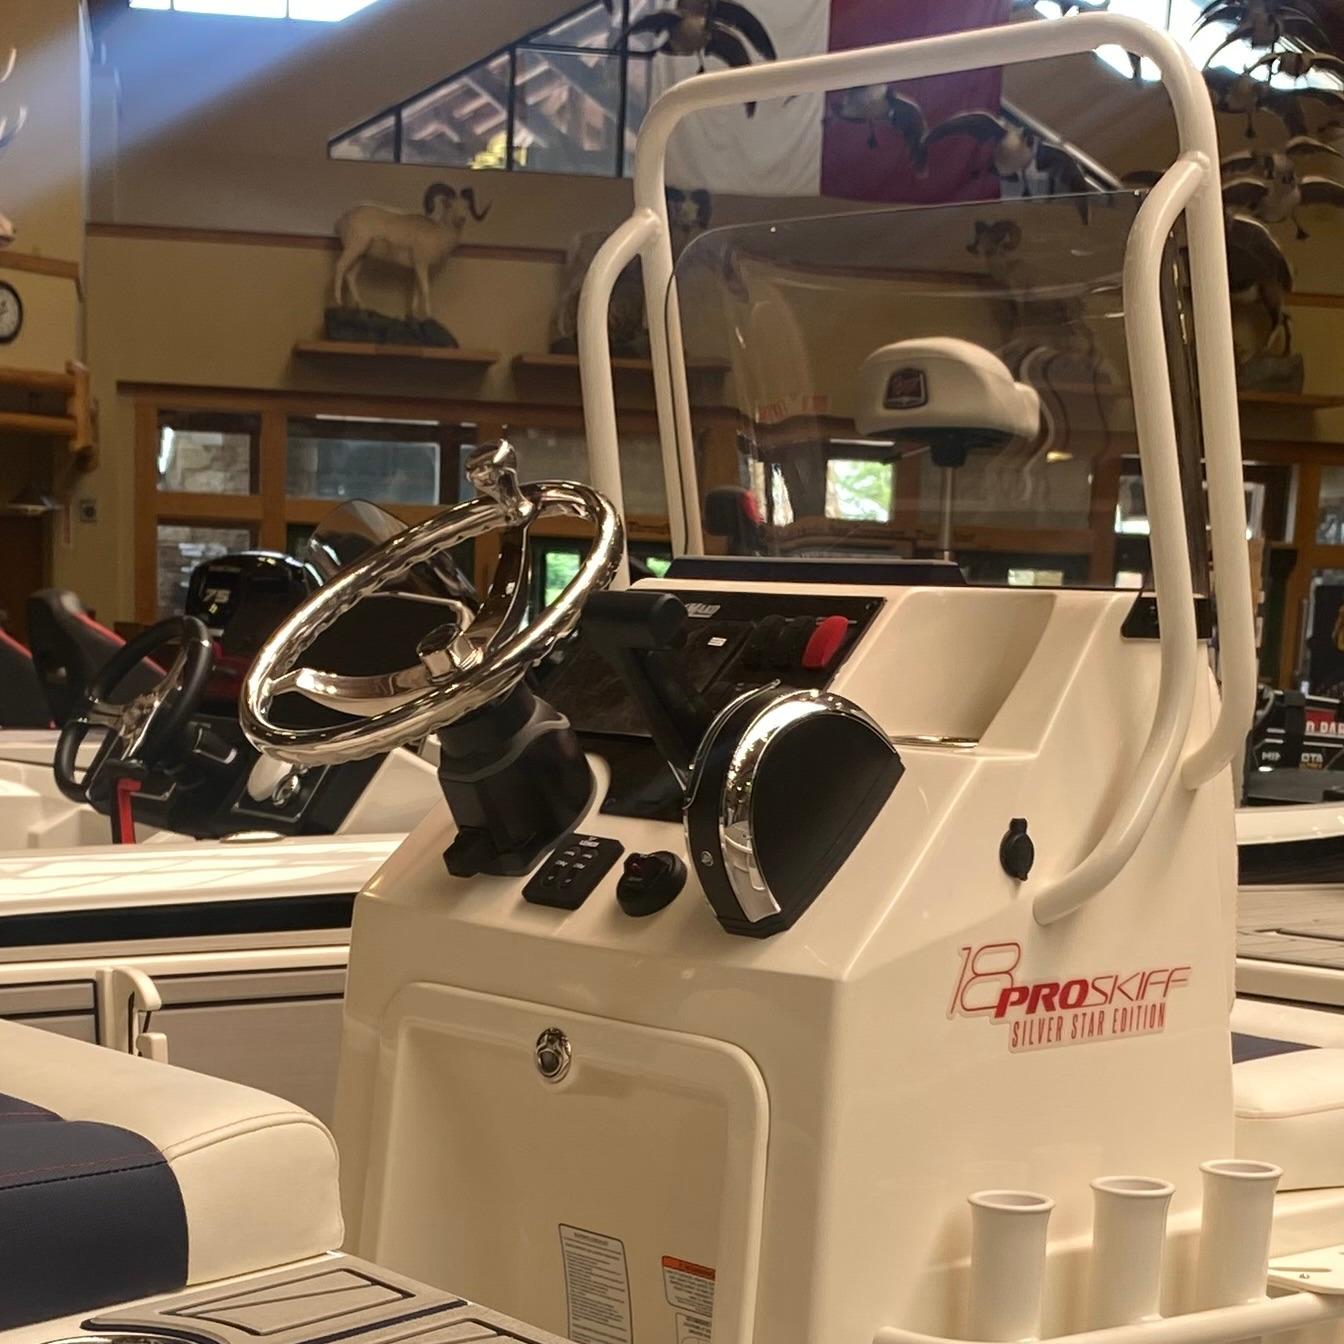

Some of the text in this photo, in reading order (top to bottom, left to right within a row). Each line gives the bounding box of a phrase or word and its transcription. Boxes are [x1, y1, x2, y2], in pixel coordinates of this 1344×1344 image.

[951, 942, 1021, 1014] 18
[1012, 1001, 1167, 1048] SILVER STAR EDITION
